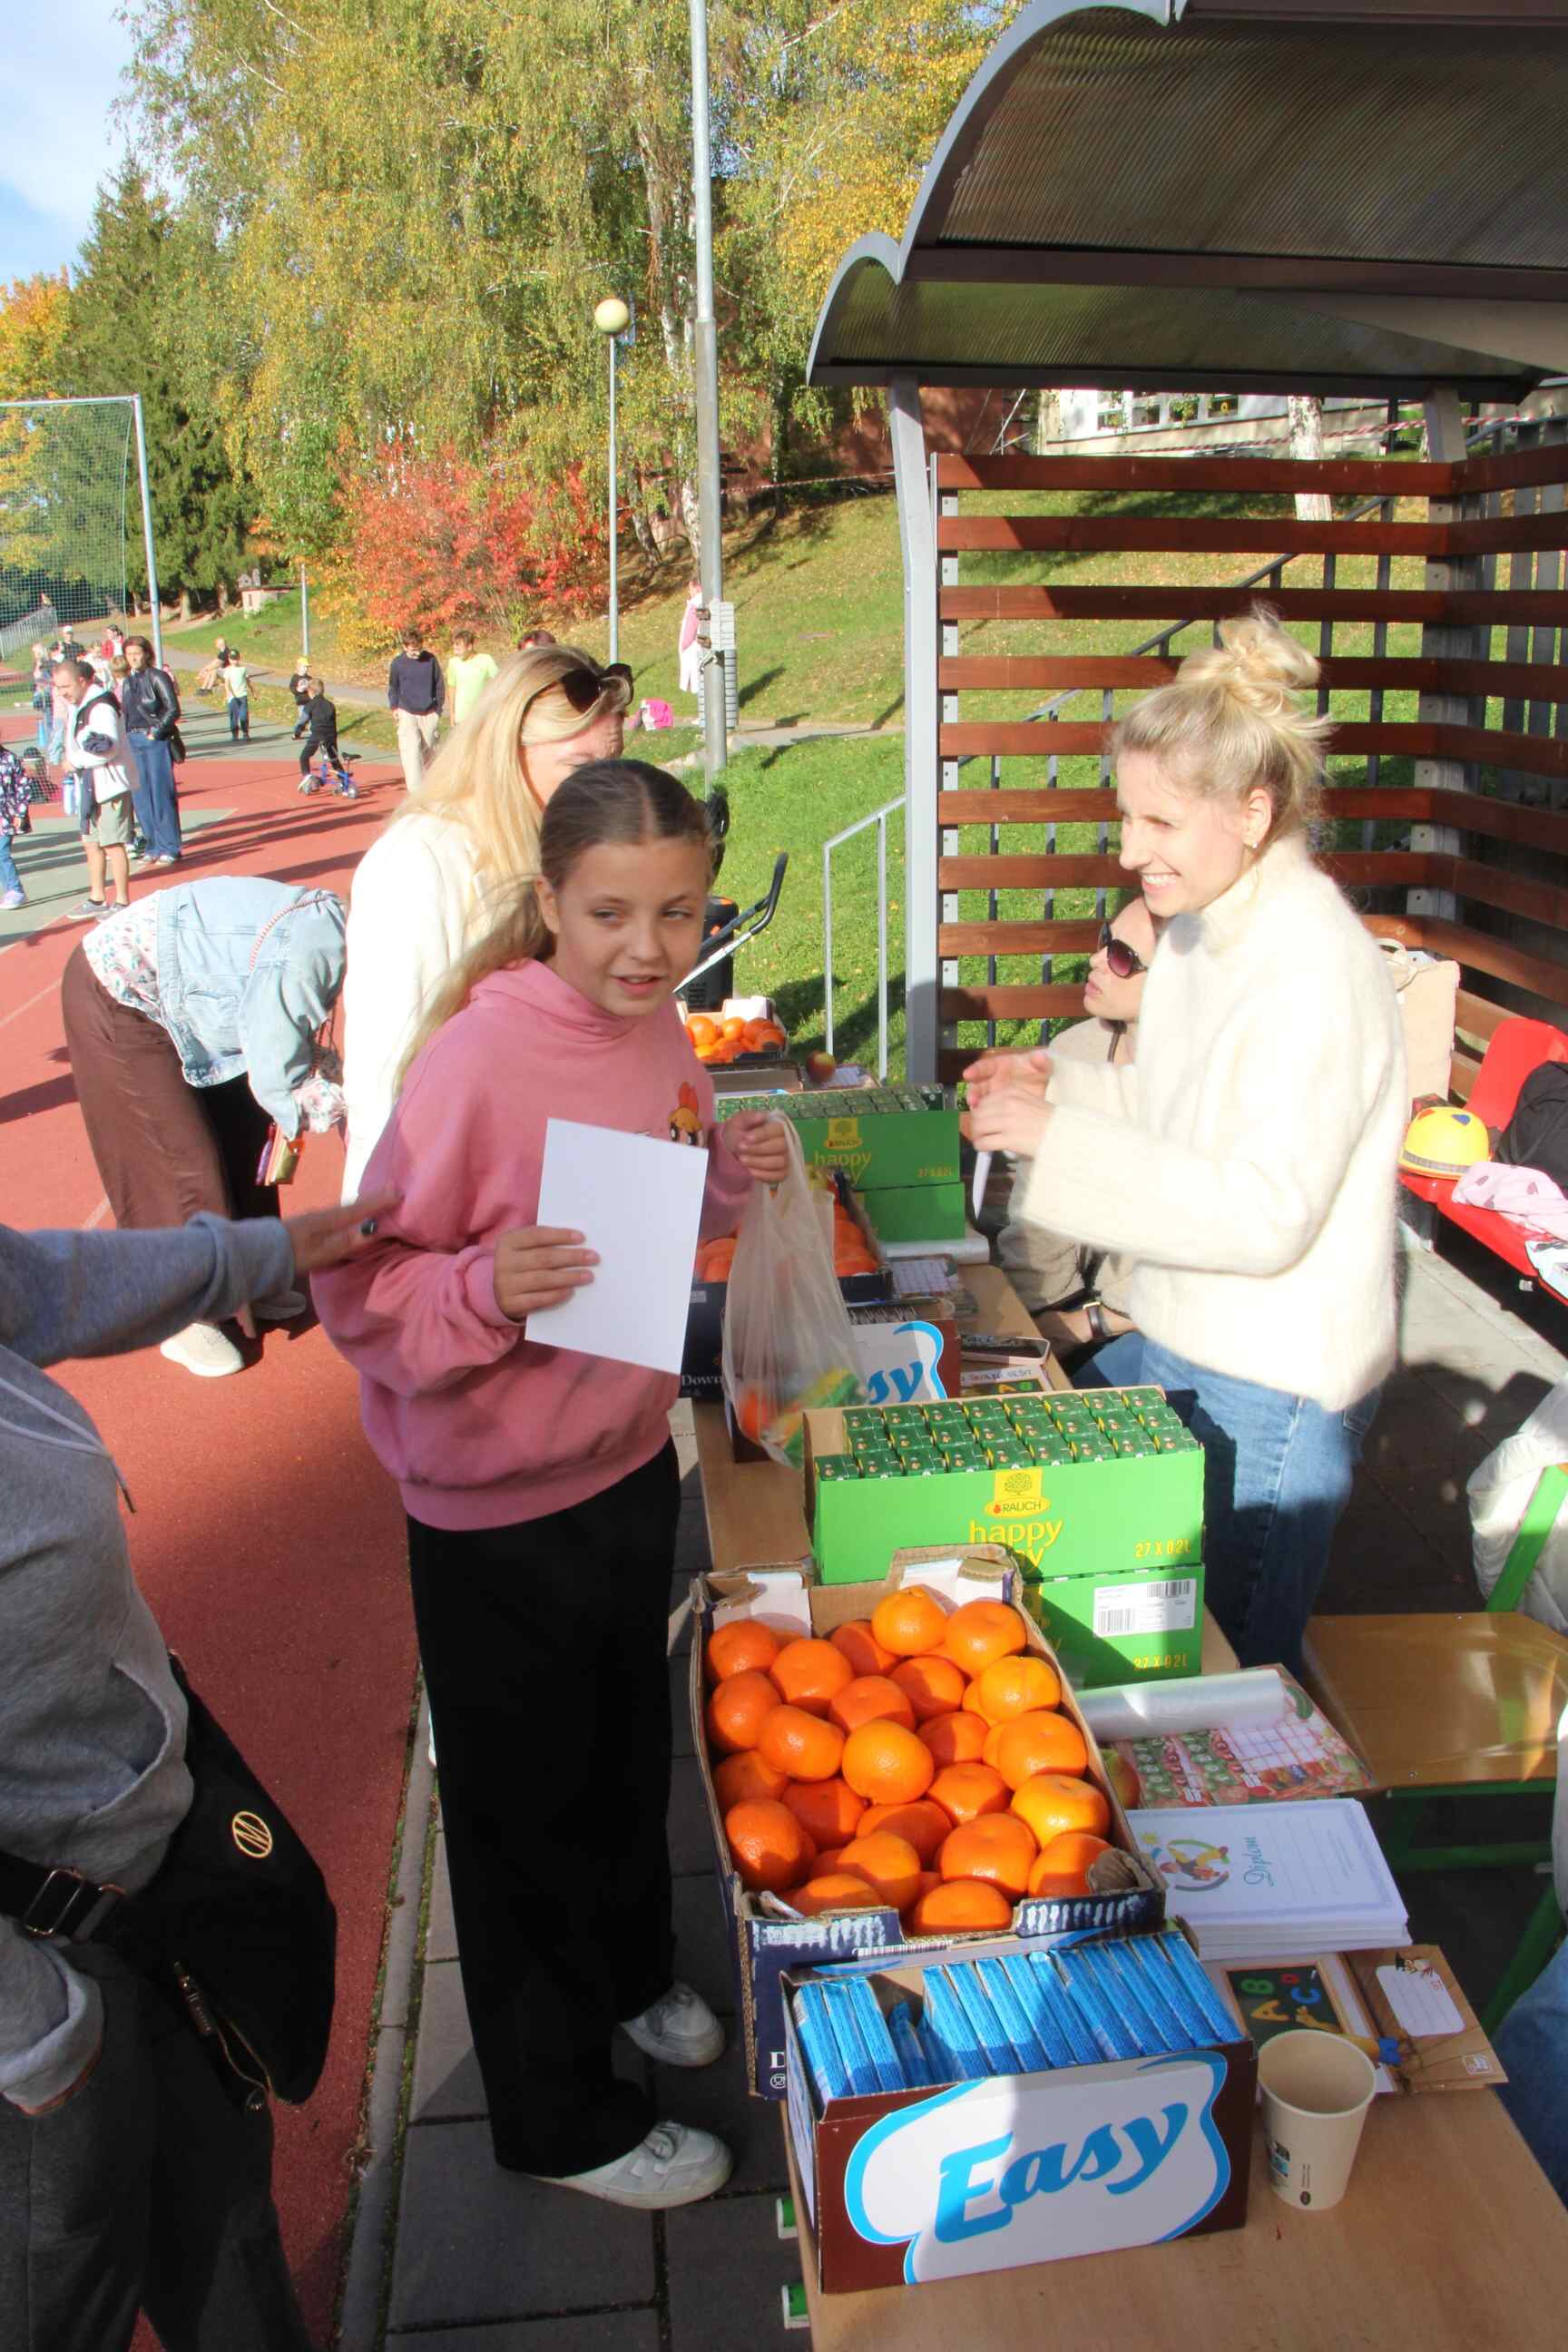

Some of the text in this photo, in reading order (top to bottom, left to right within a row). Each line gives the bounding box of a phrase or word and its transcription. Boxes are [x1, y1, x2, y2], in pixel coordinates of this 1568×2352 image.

[867, 1360, 924, 1405] sy
[1002, 1501, 1042, 1513] RAUCH
[969, 1519, 1063, 1549] happy
[1134, 1539, 1152, 1558] 27
[1243, 1836, 1275, 1887] Diplom
[935, 2102, 1189, 2244] Easy
